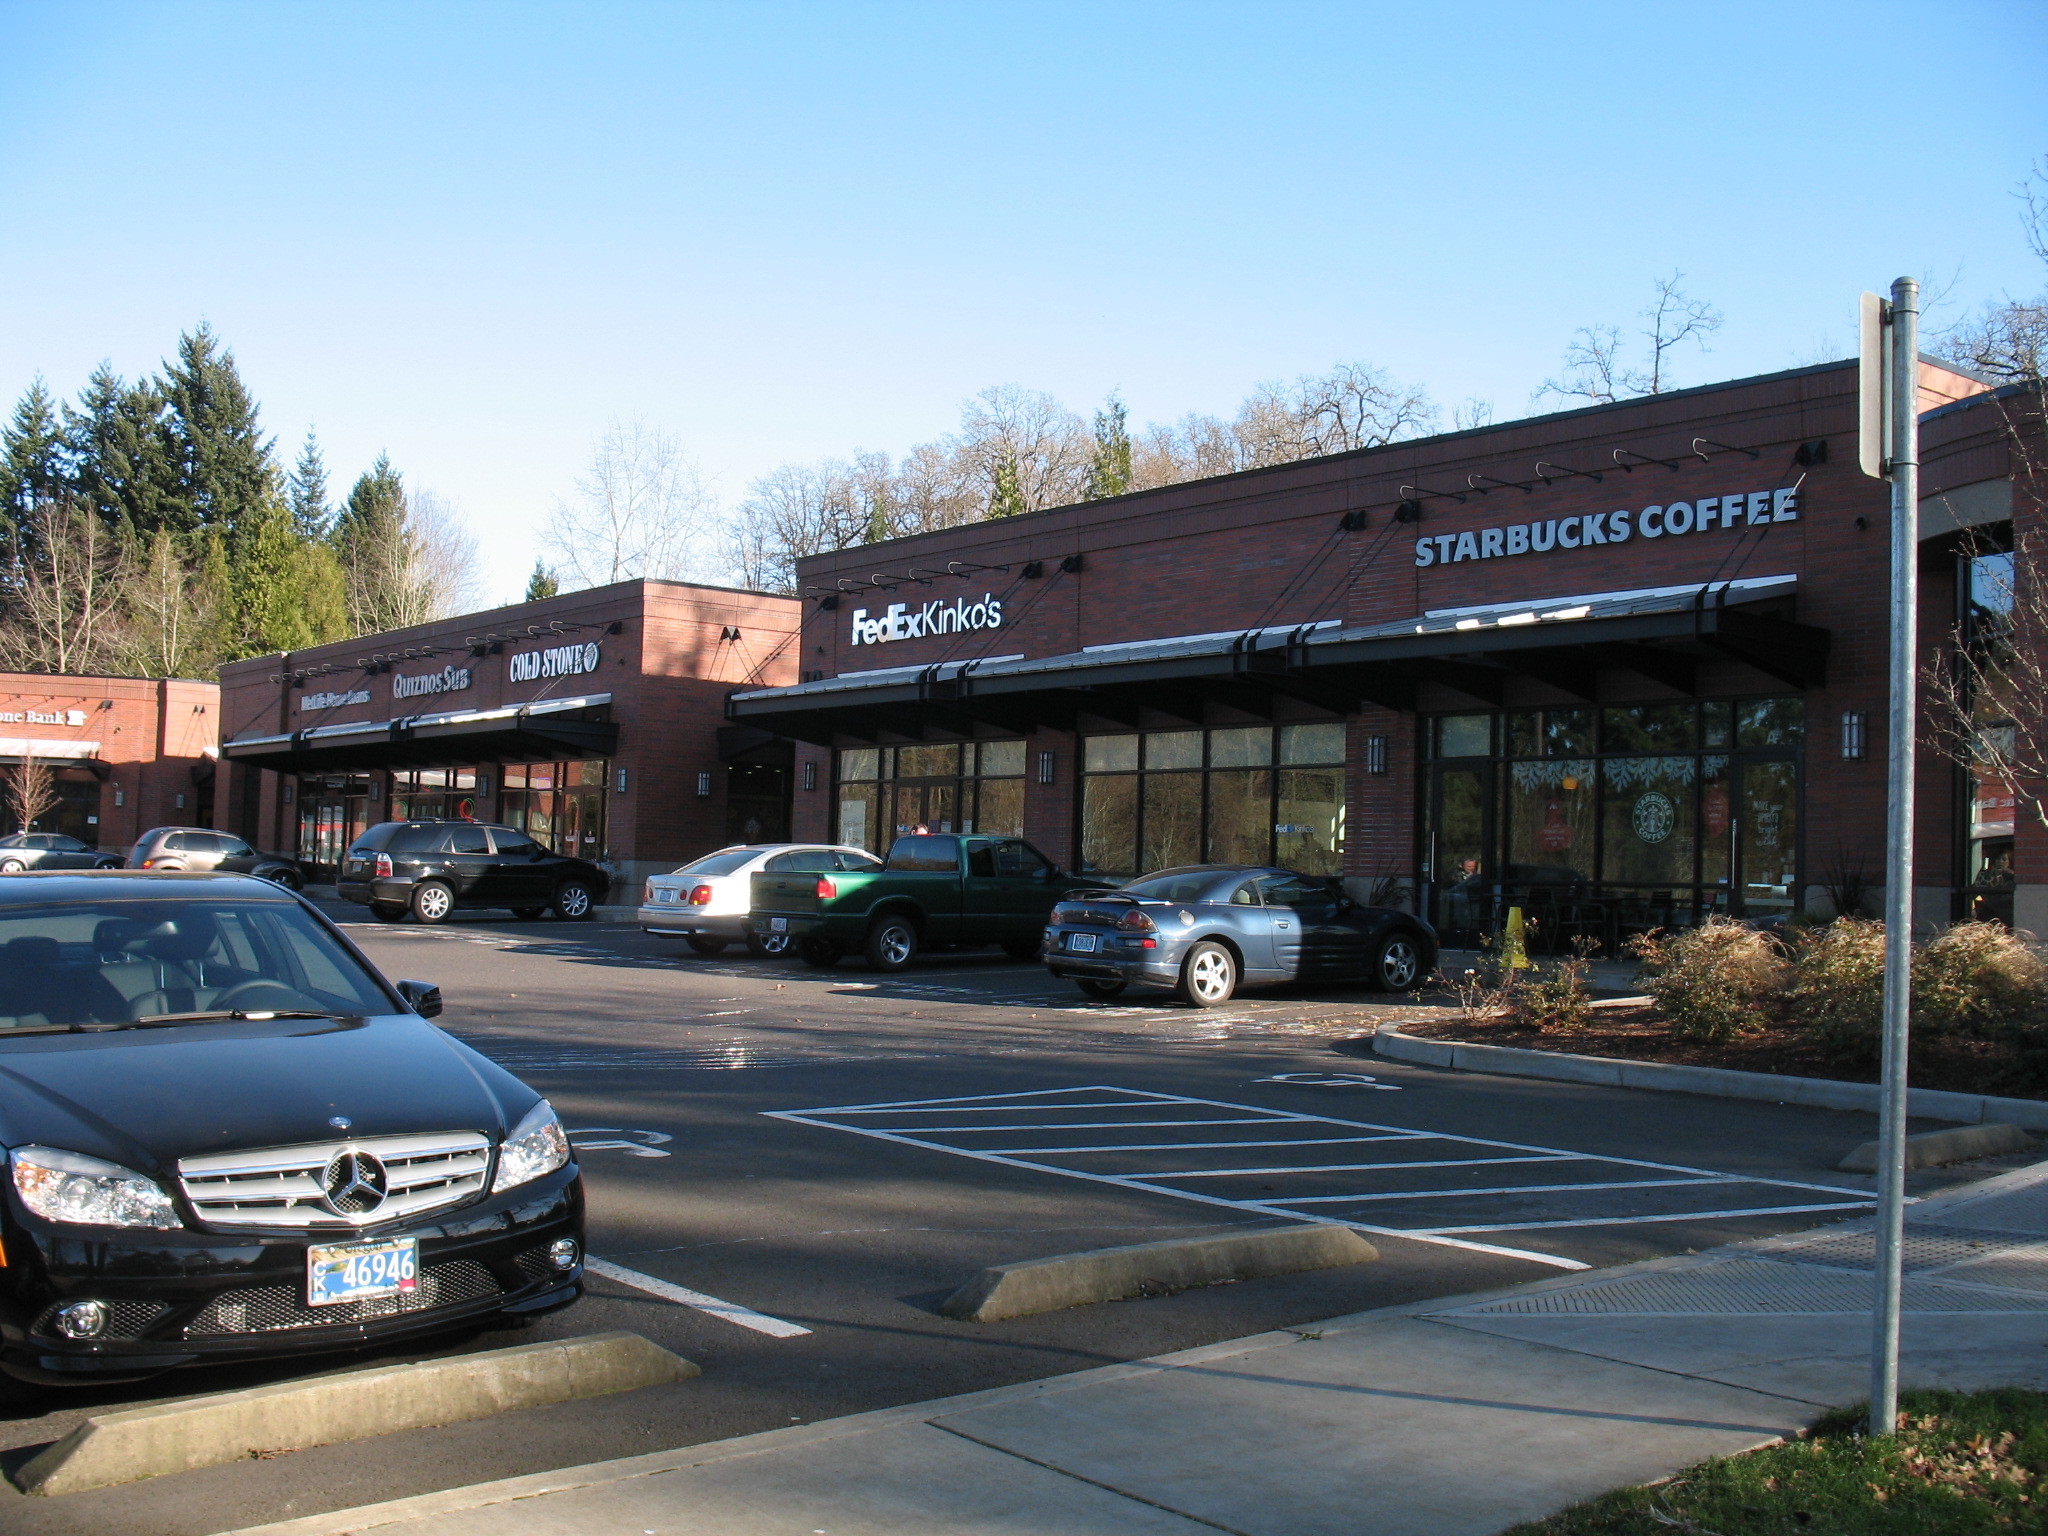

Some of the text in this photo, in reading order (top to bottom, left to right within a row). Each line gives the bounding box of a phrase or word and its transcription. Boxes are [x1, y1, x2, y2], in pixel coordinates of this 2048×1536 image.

[1415, 487, 1802, 567] STARBUCKS COFFEE
[510, 644, 584, 683] COLD STONE
[26, 710, 65, 724] Bank
[1635, 794, 1672, 815] STARBUCKS
[1639, 827, 1667, 841] COFFEE
[342, 1250, 415, 1287] 46946
